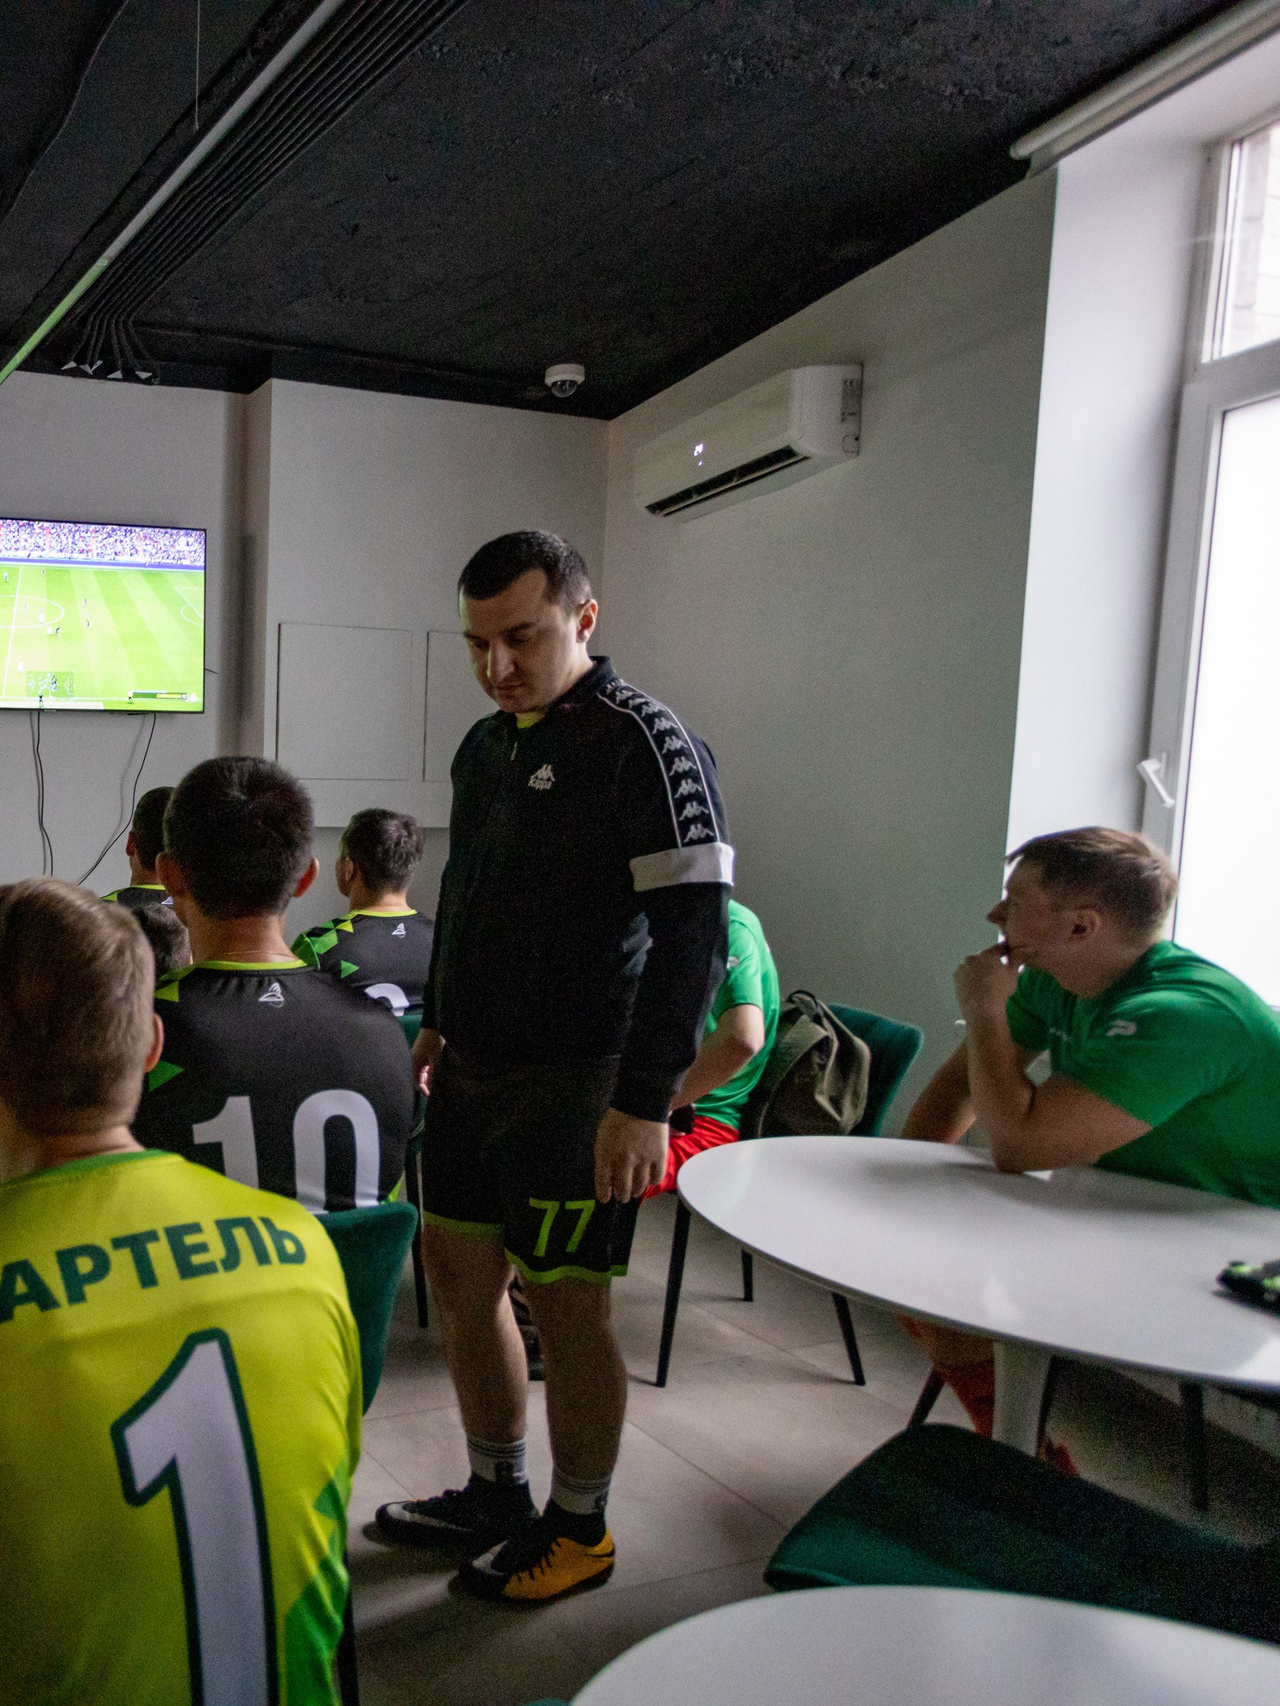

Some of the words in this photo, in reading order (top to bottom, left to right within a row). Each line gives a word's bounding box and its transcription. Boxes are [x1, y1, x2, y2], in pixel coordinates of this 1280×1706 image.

[192, 1088, 381, 1215] 10
[529, 1198, 596, 1257] 77
[110, 1327, 279, 1706] 1
